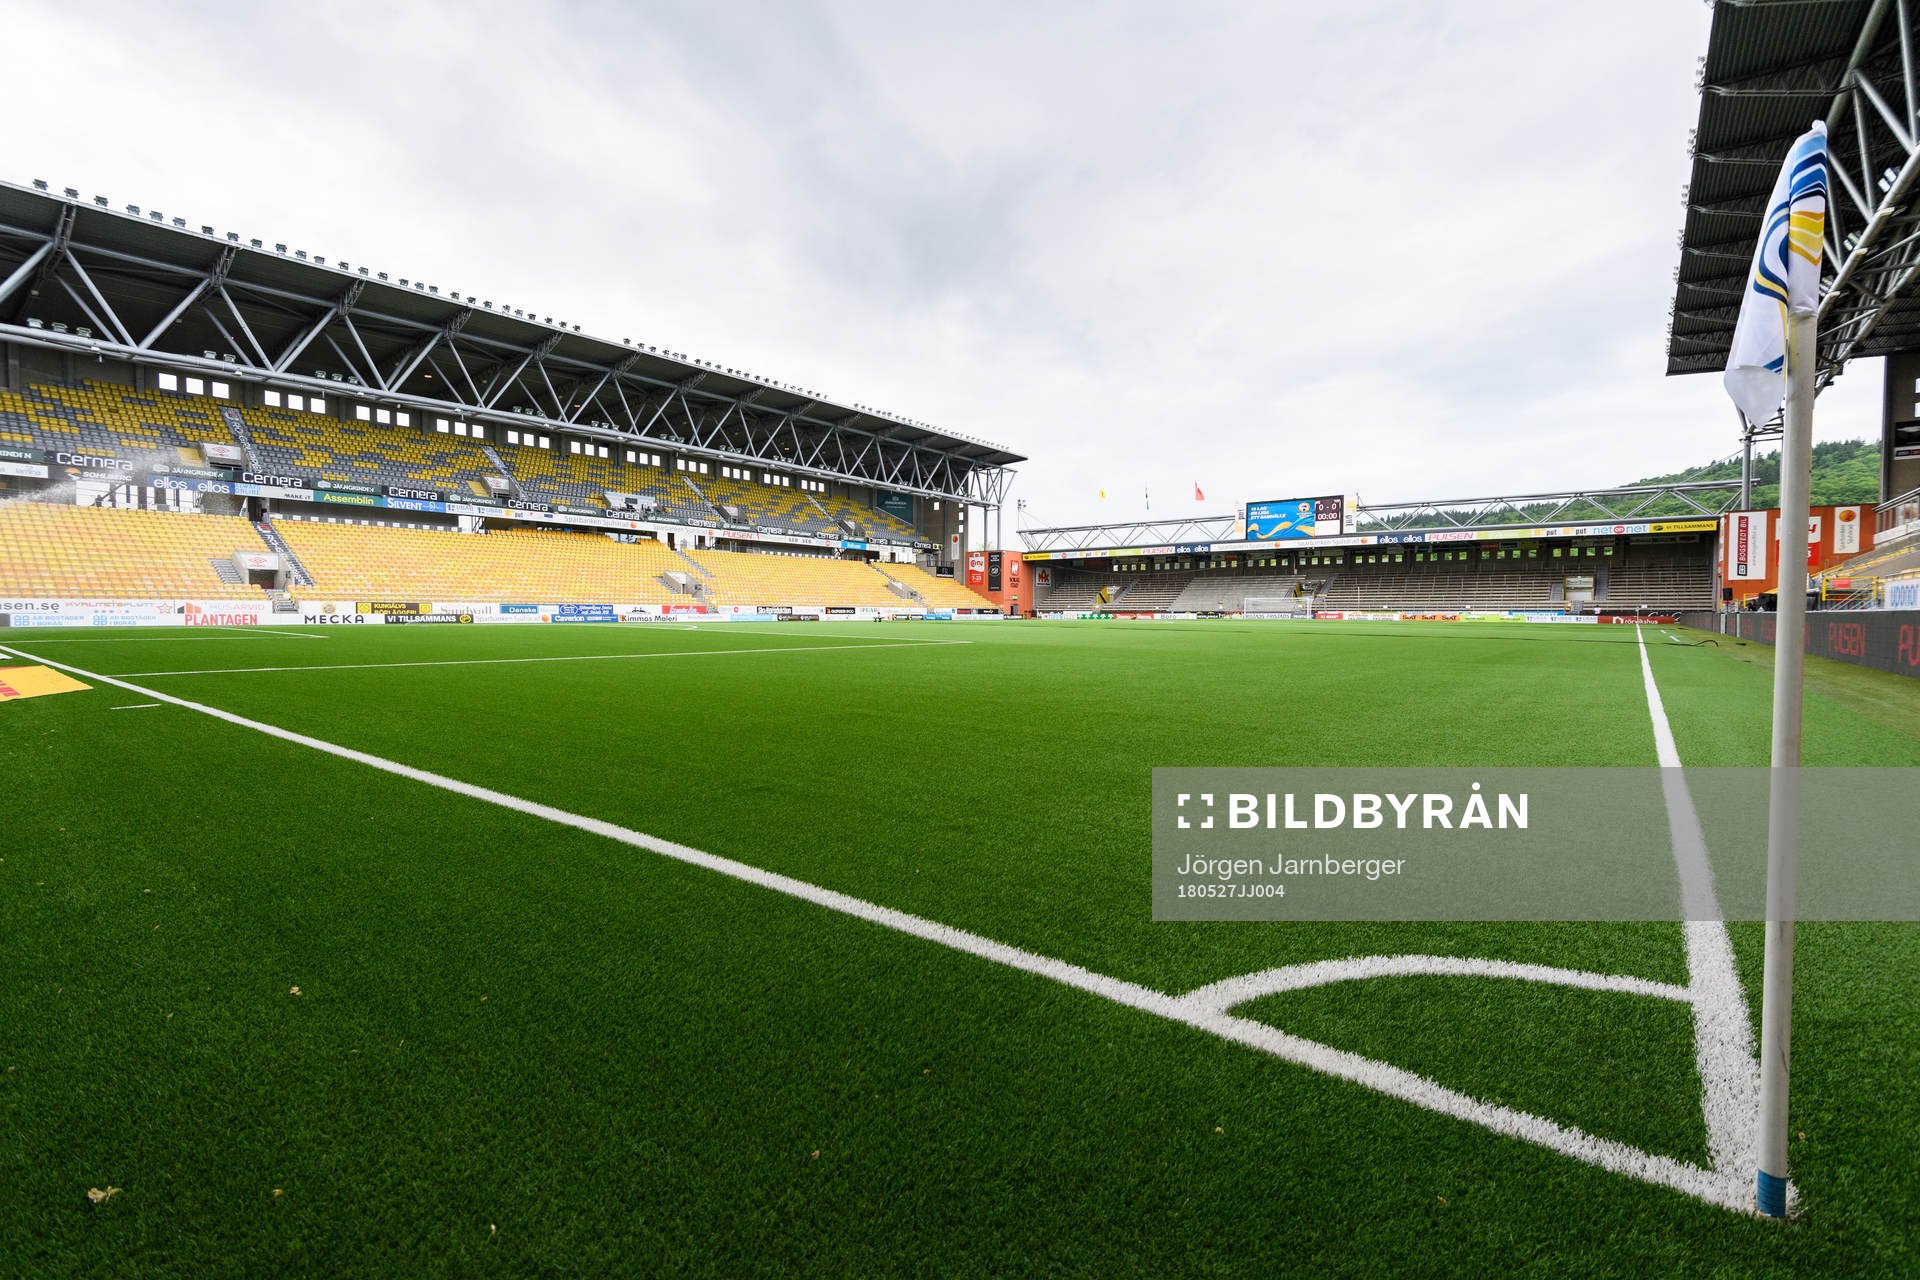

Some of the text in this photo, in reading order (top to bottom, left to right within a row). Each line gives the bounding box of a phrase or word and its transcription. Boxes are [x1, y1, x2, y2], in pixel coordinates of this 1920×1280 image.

[56, 452, 133, 471] Cernera
[153, 476, 188, 490] ellos
[197, 480, 230, 494] ellos
[242, 472, 302, 488] Cernera
[323, 493, 374, 505] Assemblin
[388, 486, 437, 501] Cernera
[508, 499, 548, 512] Cernera
[1317, 512, 1338, 521] 00:00
[1380, 535, 1422, 544] ellos ellos
[184, 613, 258, 626] PLANTAGEN
[304, 614, 365, 625] MECKA
[387, 614, 456, 623] VI TILLSAMMANS
[1828, 622, 1866, 657] PULSEN
